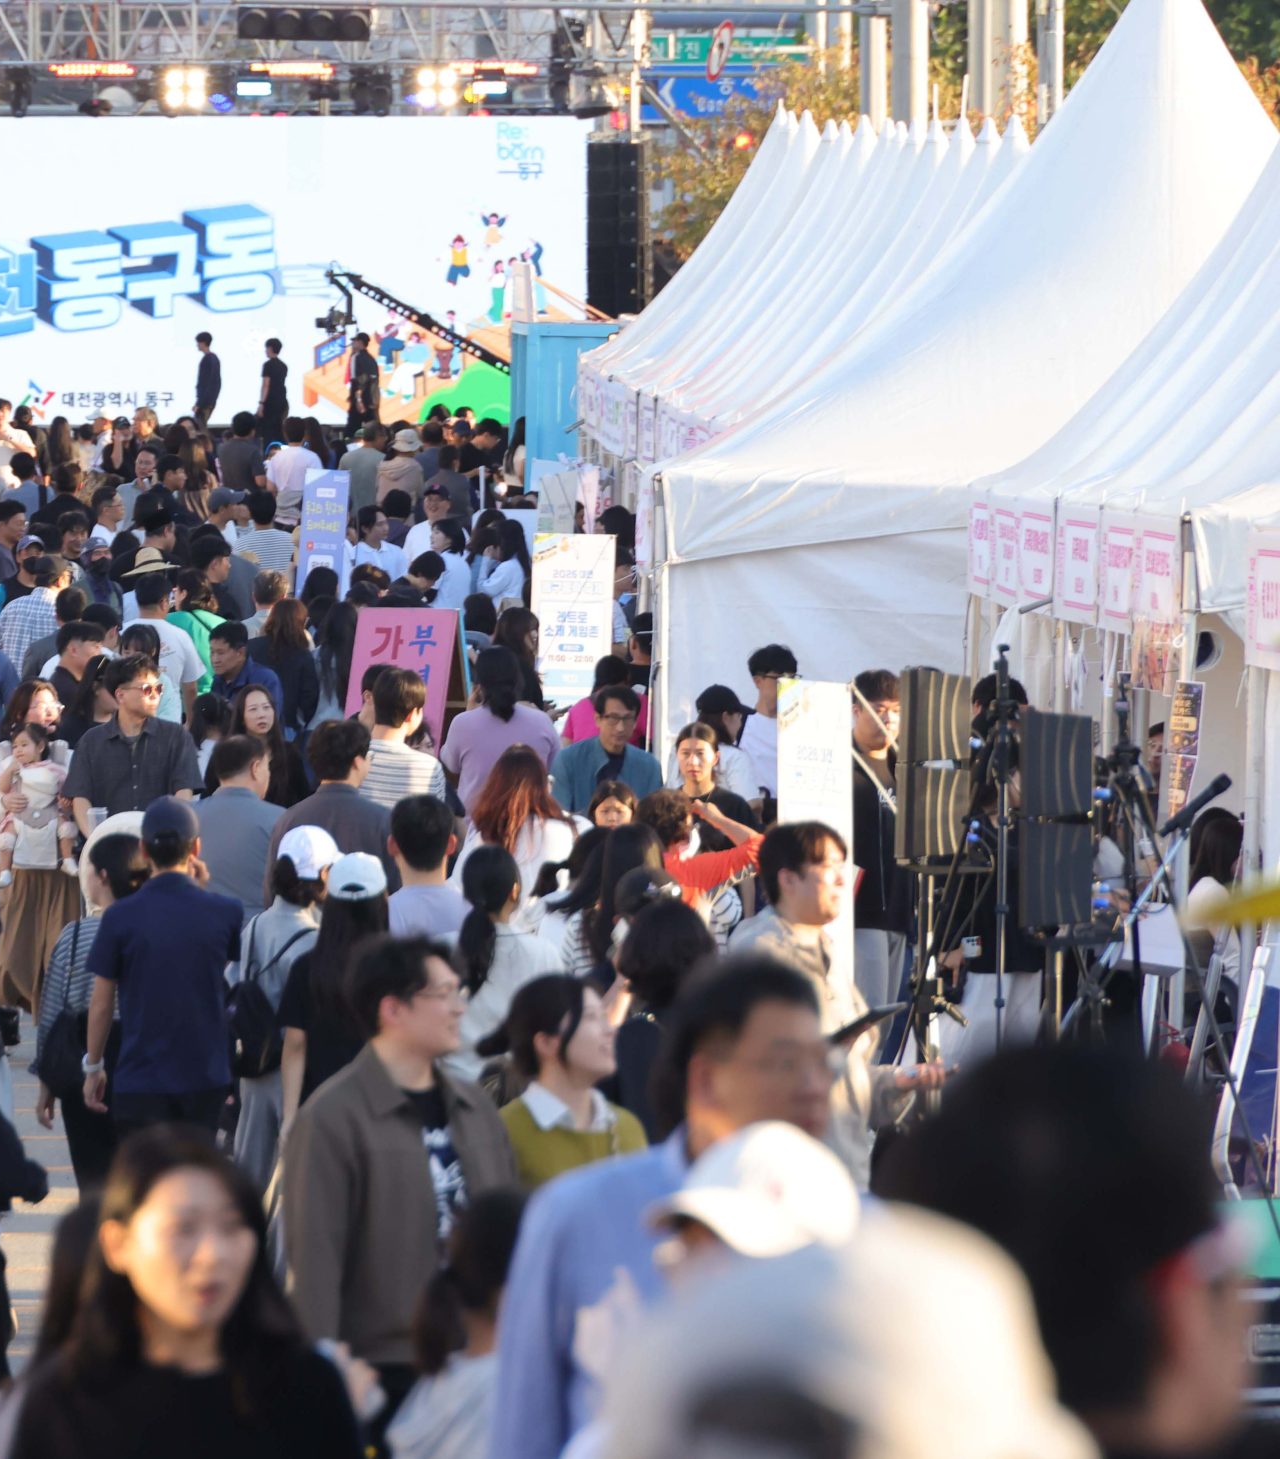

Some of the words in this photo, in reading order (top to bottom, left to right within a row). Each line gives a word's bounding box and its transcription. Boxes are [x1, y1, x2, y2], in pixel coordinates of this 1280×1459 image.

[518, 162, 543, 180] 동구
[62, 391, 138, 408] 대전광역시
[145, 391, 174, 408] 동구
